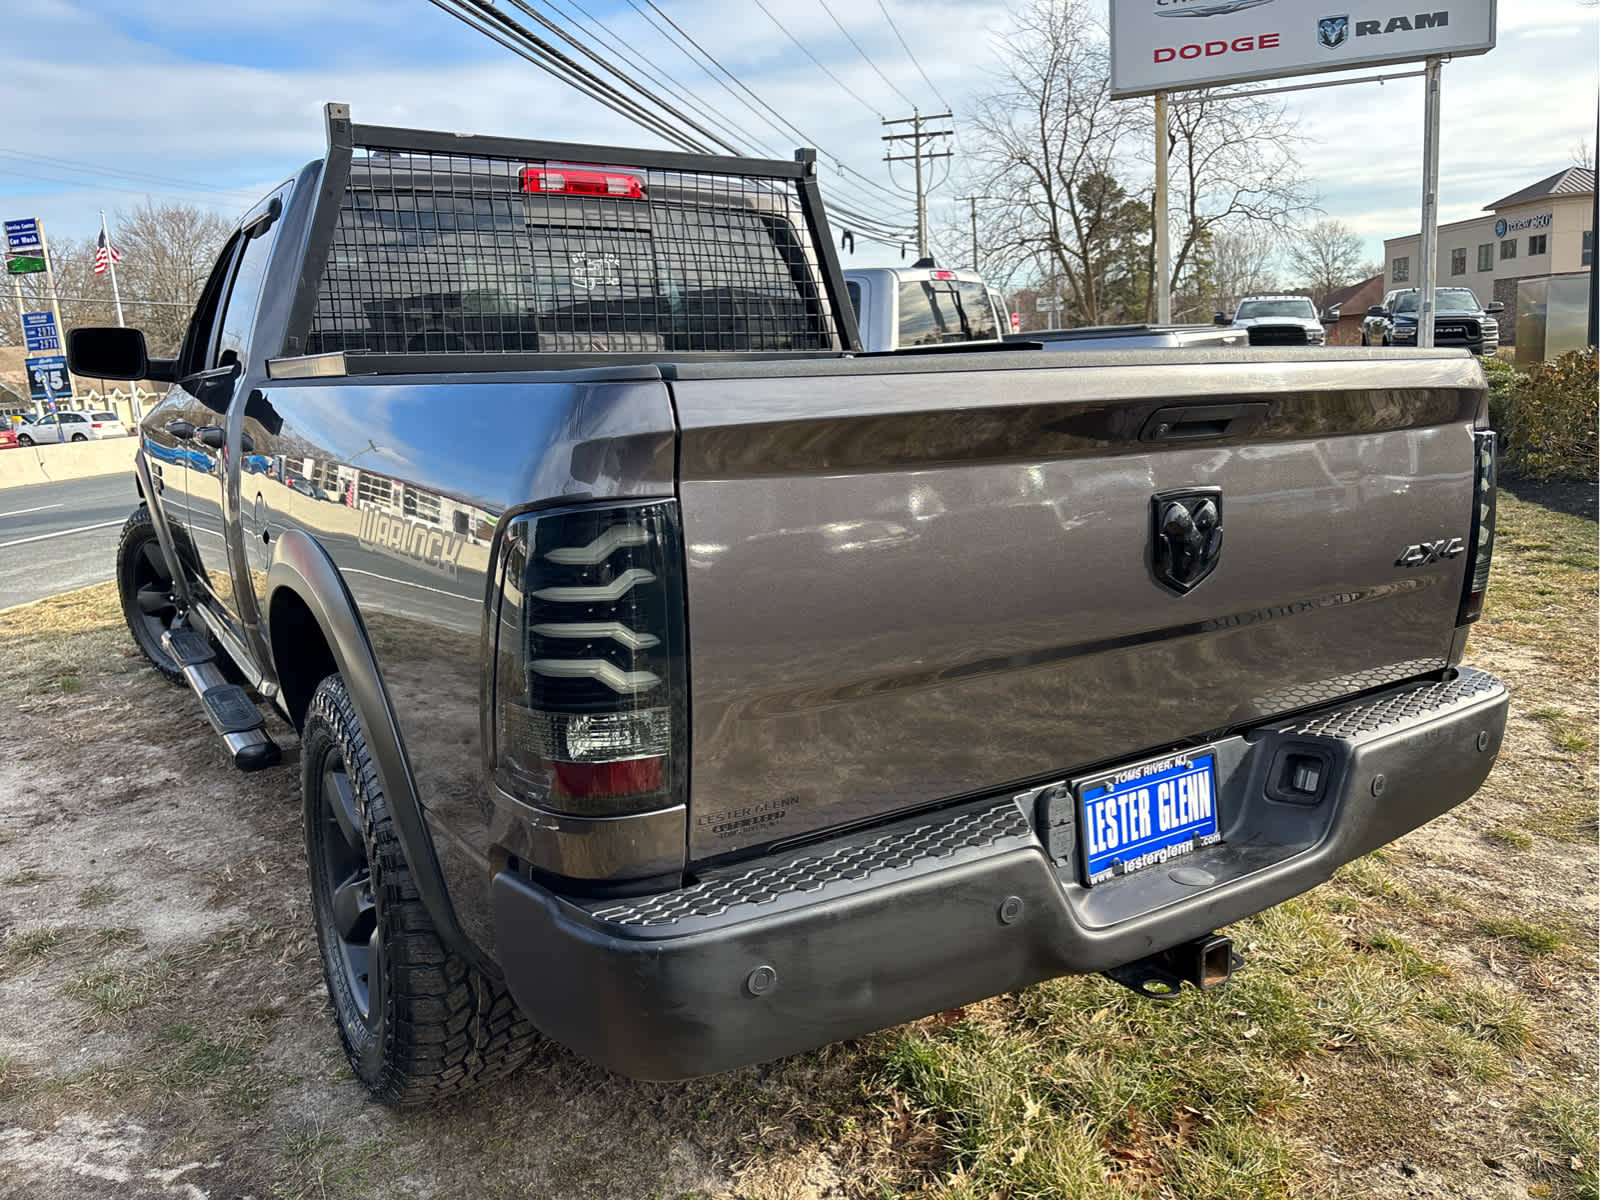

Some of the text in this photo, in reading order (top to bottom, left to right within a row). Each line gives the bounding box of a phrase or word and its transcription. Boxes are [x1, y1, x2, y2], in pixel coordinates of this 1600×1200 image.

[1355, 11, 1449, 36] RAM
[1153, 32, 1280, 63] DODGE
[21, 235, 37, 243] Wash
[359, 503, 466, 583] WARLOCK
[1114, 768, 1142, 785] TOMS
[1175, 755, 1187, 768] NJ
[697, 808, 752, 826] LESTER
[755, 796, 799, 813] GLENN
[1086, 771, 1211, 855] LESTER GLENN
